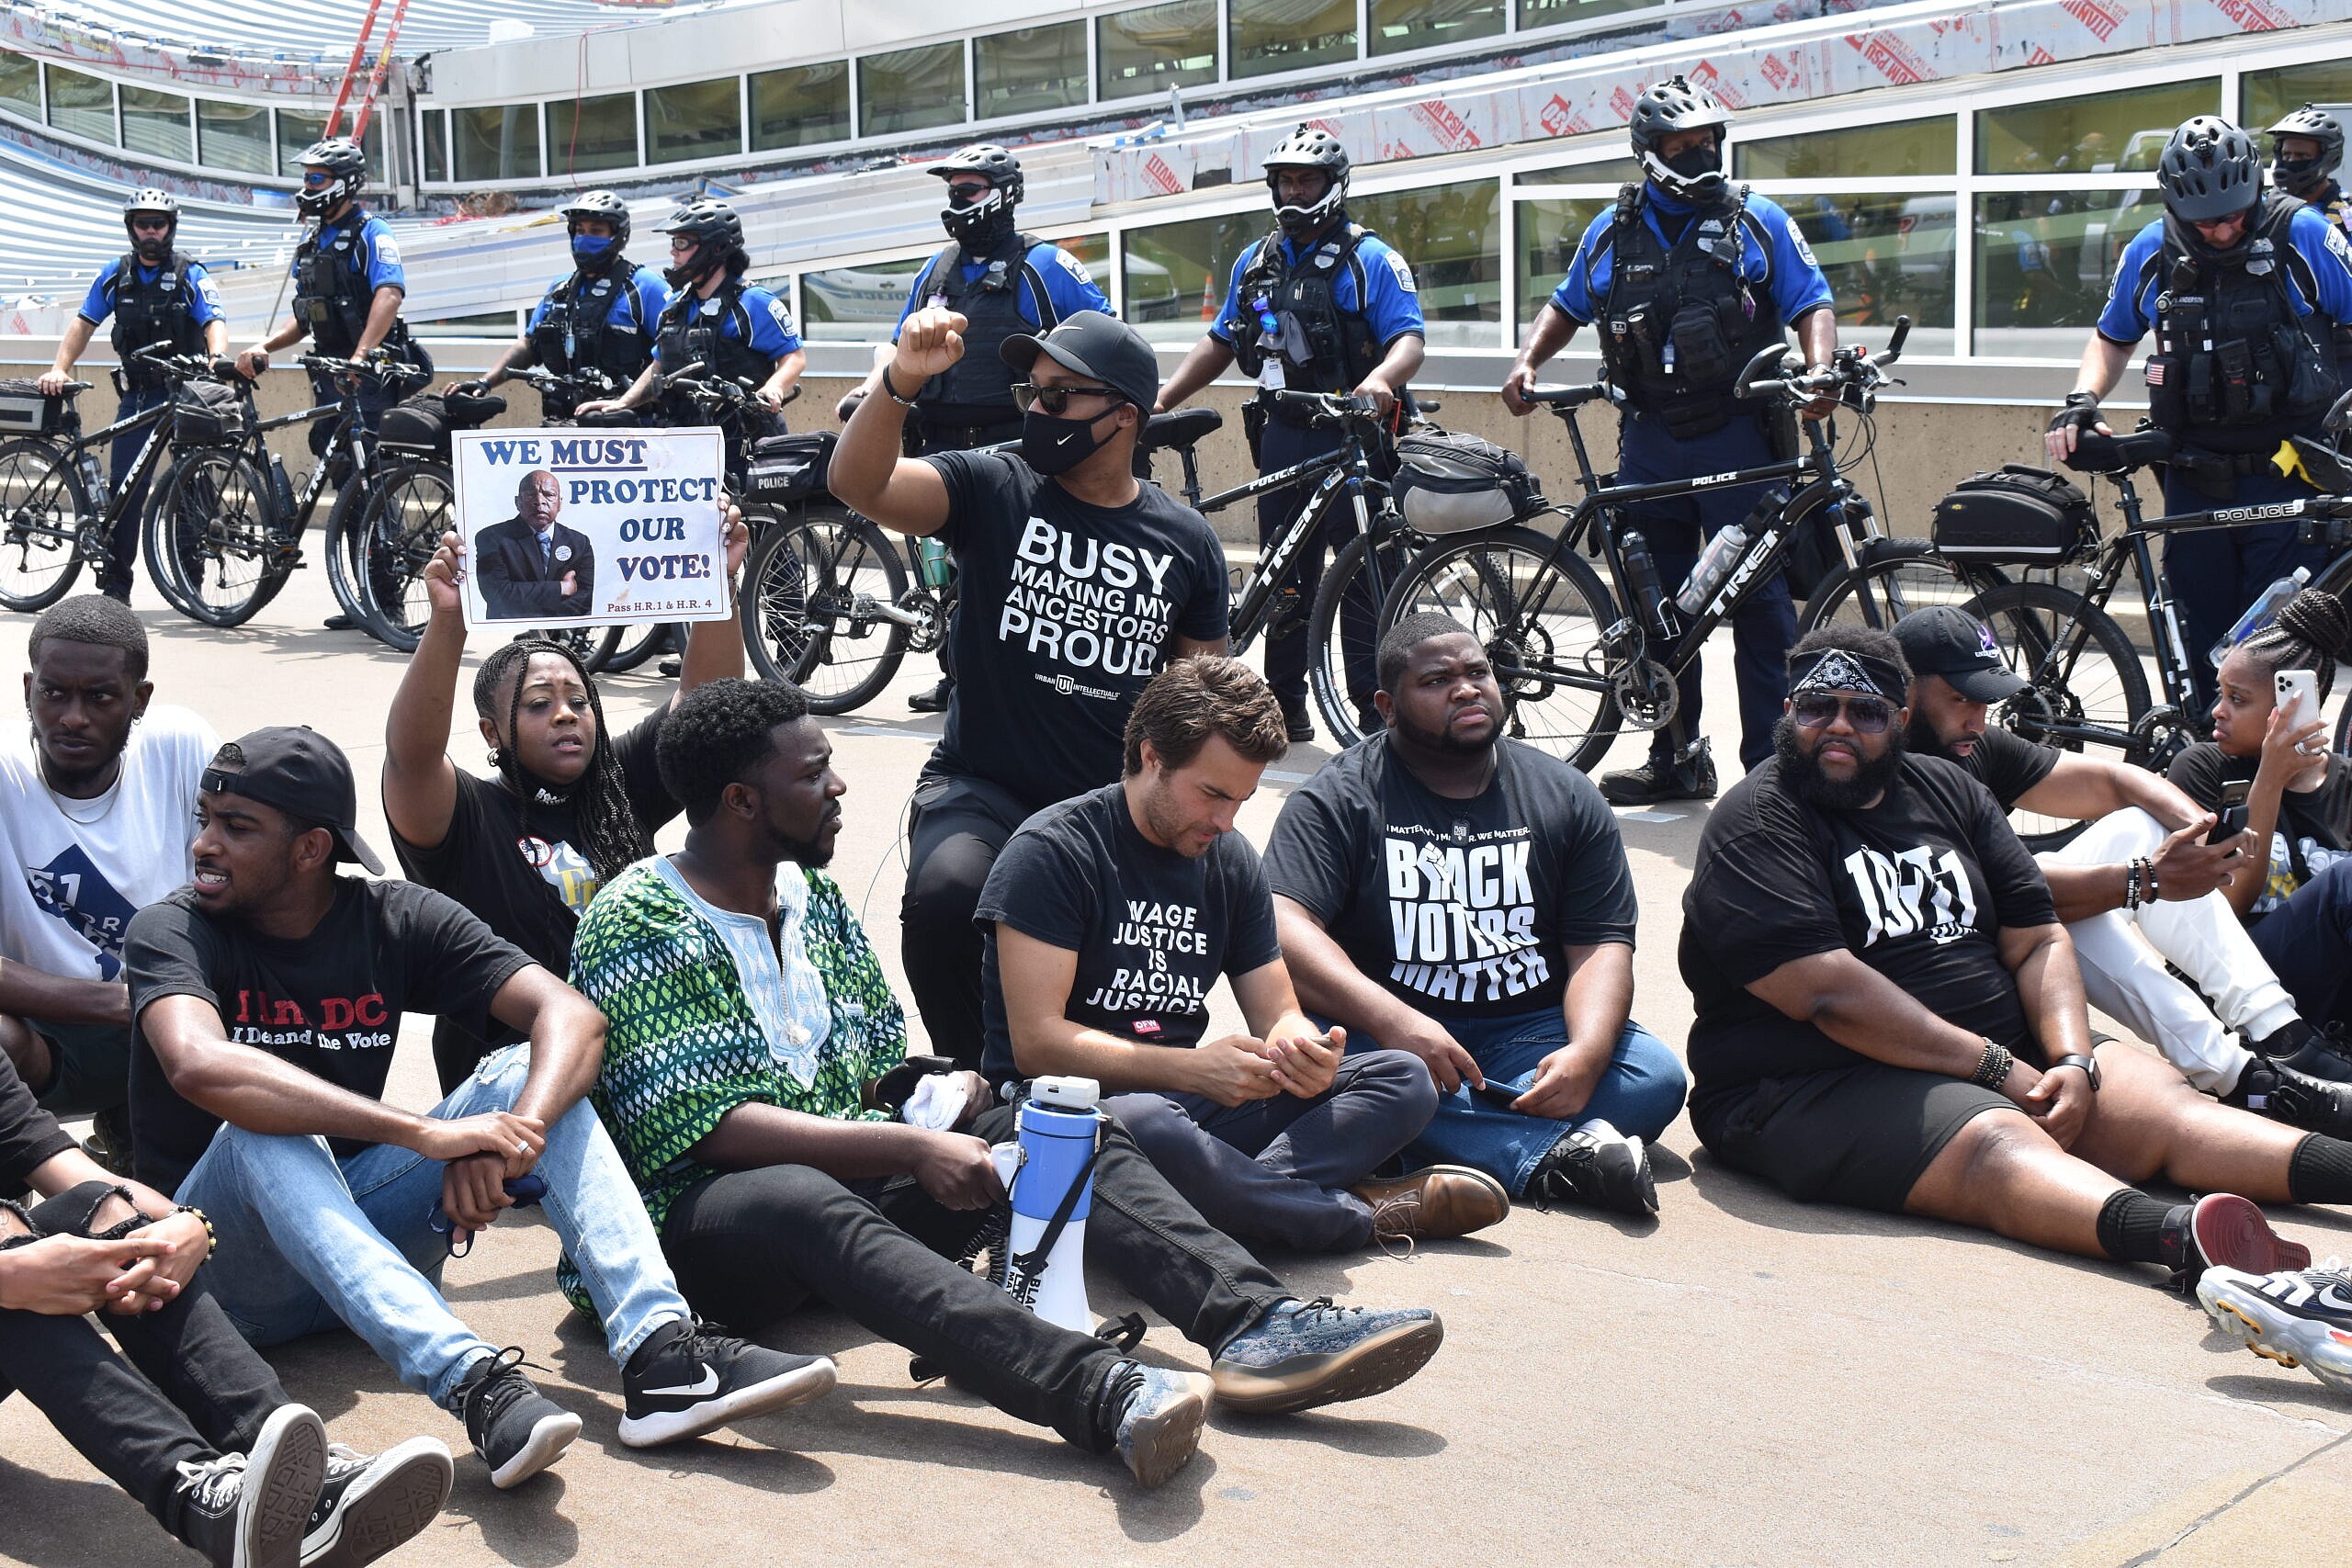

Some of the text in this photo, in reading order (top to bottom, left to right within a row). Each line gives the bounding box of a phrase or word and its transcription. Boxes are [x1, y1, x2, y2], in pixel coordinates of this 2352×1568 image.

[118, 429, 159, 496] TREK
[480, 439, 648, 466] WE MUST
[569, 477, 718, 505] PROTECT
[758, 477, 790, 490] POLICE
[1249, 466, 1297, 491] POLICE
[1691, 471, 1737, 487] POLICE
[2213, 504, 2297, 523] POLICE
[619, 516, 686, 542] OUR
[1257, 488, 1324, 587] TREK
[616, 553, 711, 582] VOTE!
[1016, 515, 1174, 595] BUSY
[1010, 558, 1172, 622] MAKING MY
[606, 603, 631, 613] Pass
[665, 601, 674, 610] &
[676, 600, 701, 610] H.R.
[706, 599, 712, 609] 4
[1005, 585, 1169, 644] ANCESTORS
[999, 604, 1165, 675] PROUD
[1035, 673, 1057, 685] URBAN
[1058, 678, 1072, 692] UI
[1073, 683, 1121, 698] INTELLECTUALS
[1477, 830, 1494, 840] WE
[1494, 826, 1532, 839] MATTER.
[28, 867, 82, 908] 51
[1125, 899, 1197, 930] WAGE
[1112, 922, 1207, 955] JUSTICE
[1389, 899, 1541, 963] VOTERS
[1148, 948, 1168, 972] IS
[1389, 945, 1552, 1003] MATTER
[1111, 968, 1204, 998] RACIAL
[236, 988, 251, 1022] I
[321, 992, 389, 1031] DC
[1086, 987, 1200, 1016] JUSTICE
[232, 1026, 244, 1043] I
[318, 1032, 342, 1051] the
[345, 1031, 392, 1049] Vote
[1135, 1019, 1158, 1029] OFW
